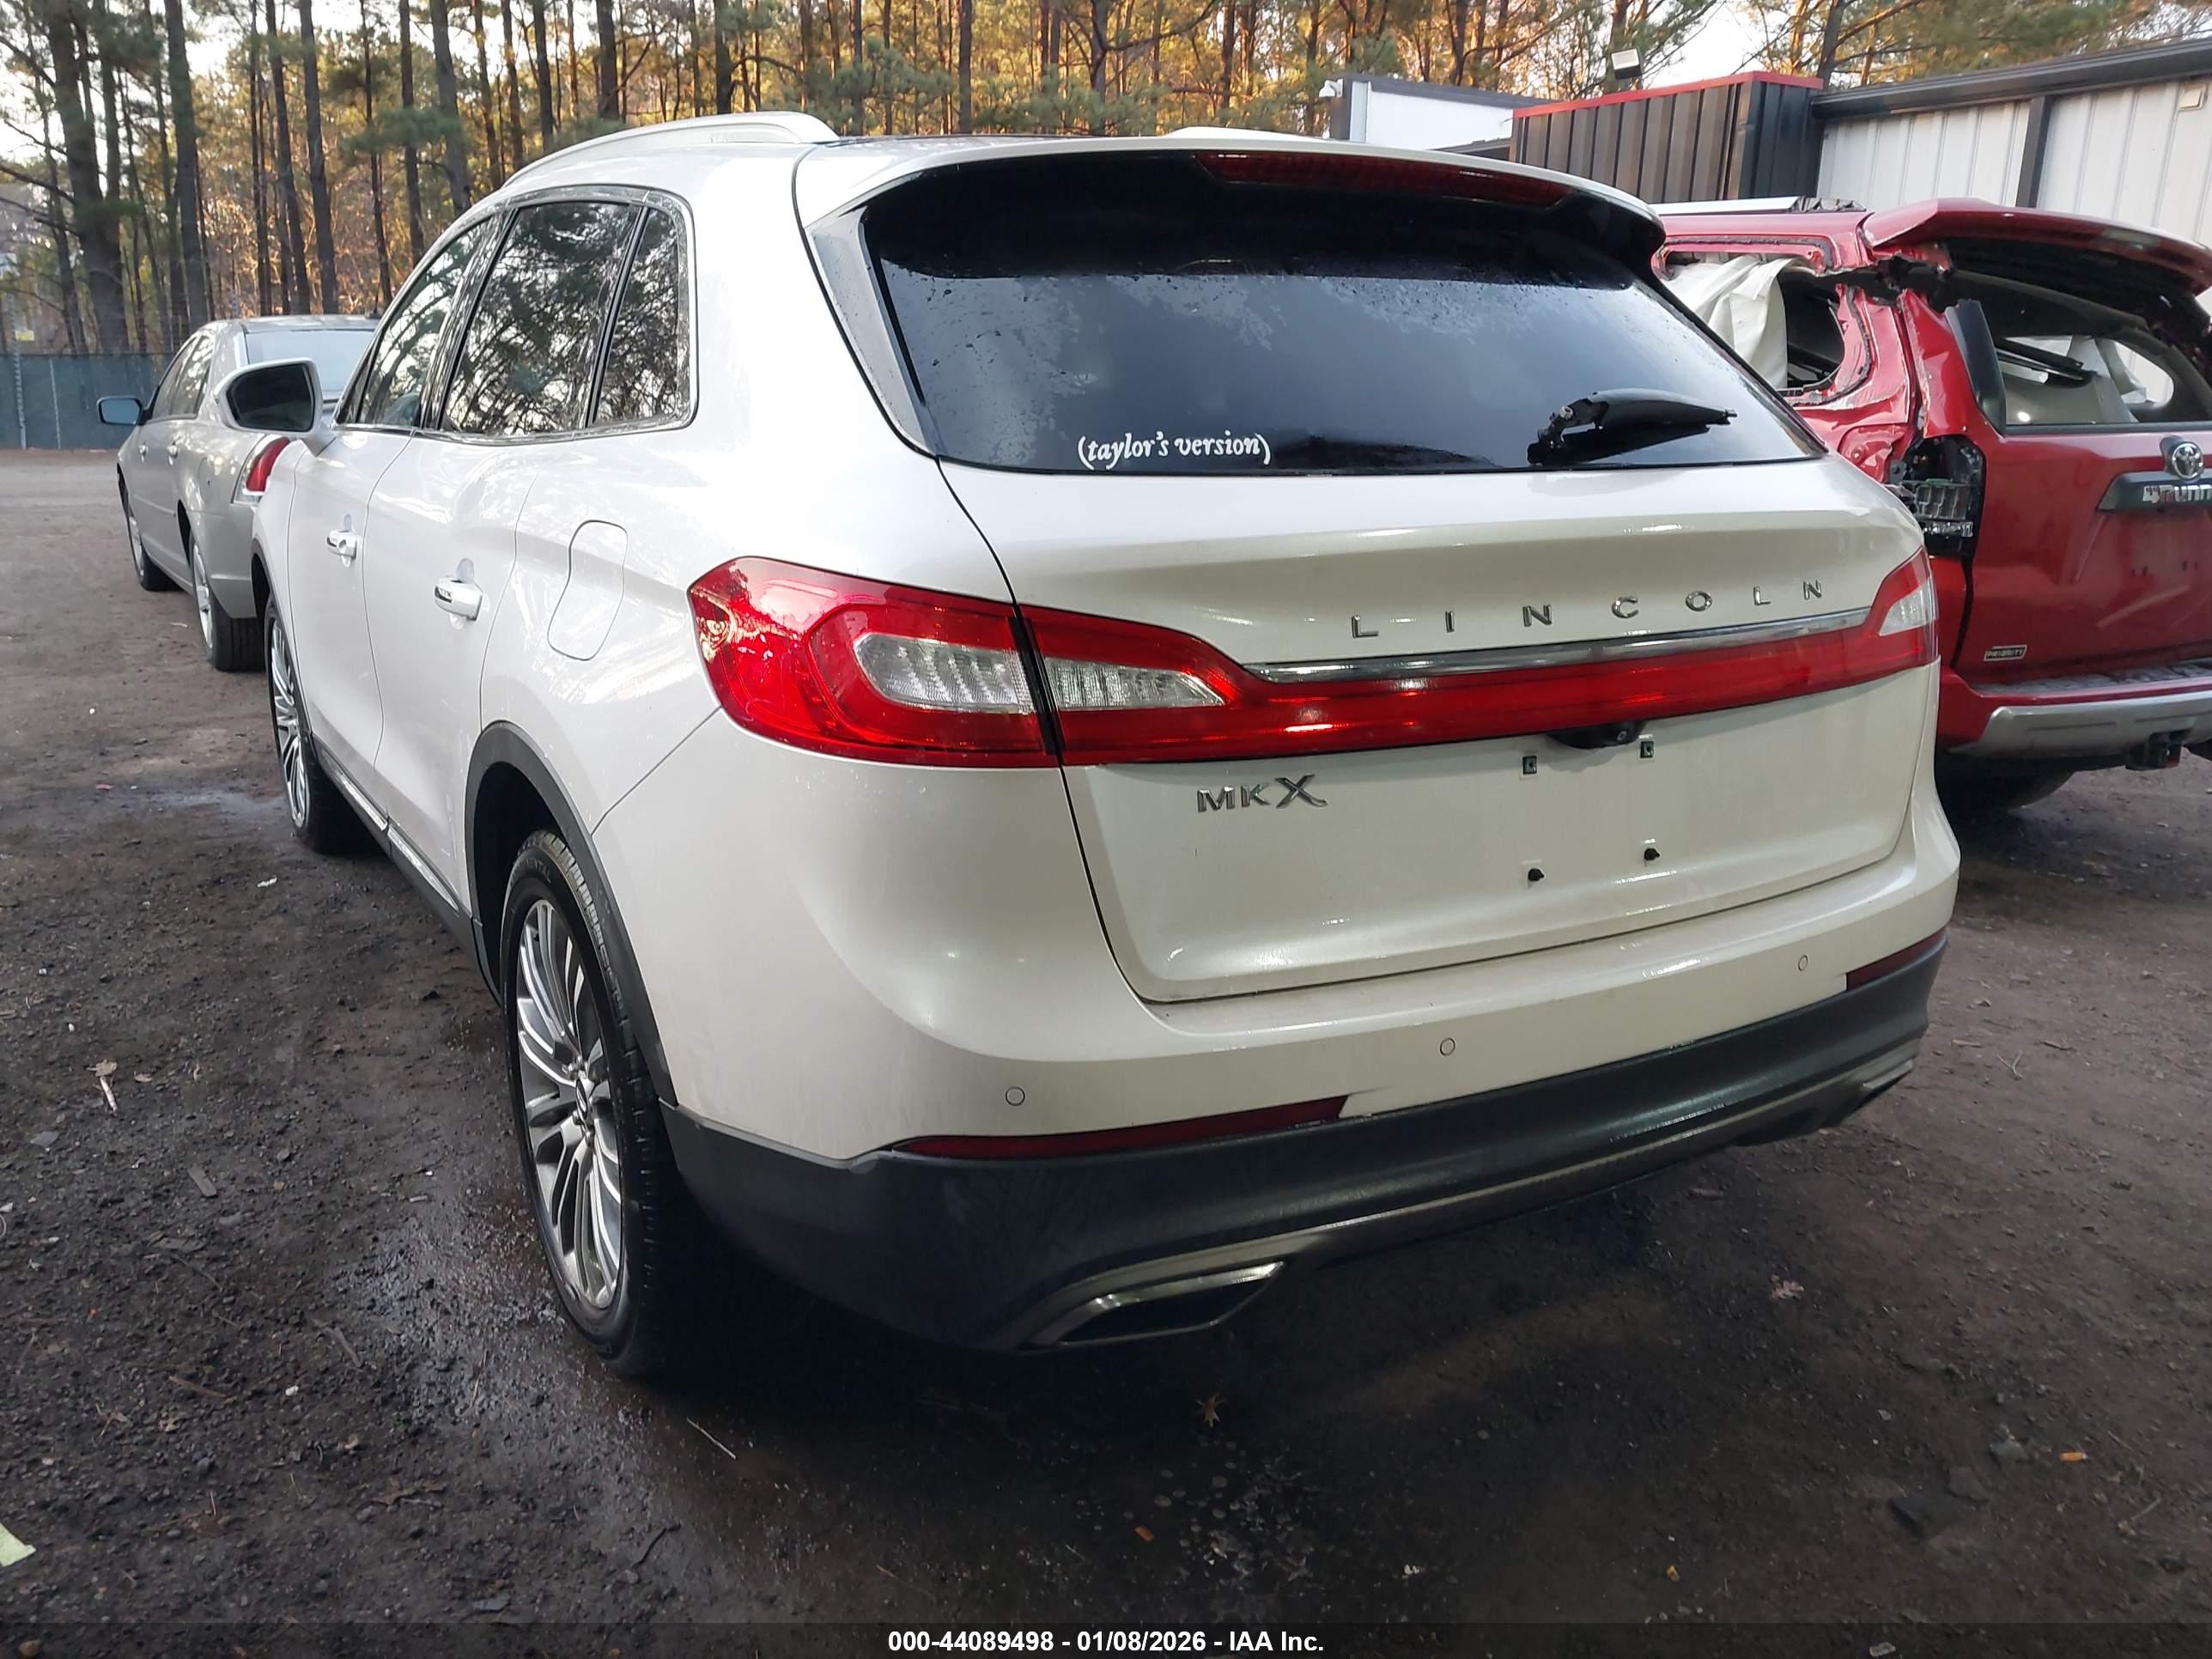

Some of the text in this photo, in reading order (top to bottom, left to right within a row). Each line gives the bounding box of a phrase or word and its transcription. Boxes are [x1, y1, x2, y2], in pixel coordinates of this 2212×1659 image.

[1078, 429, 1272, 471] (taylor's version)
[1351, 579, 1824, 640] LINCOLN
[1196, 774, 1328, 813] MKX
